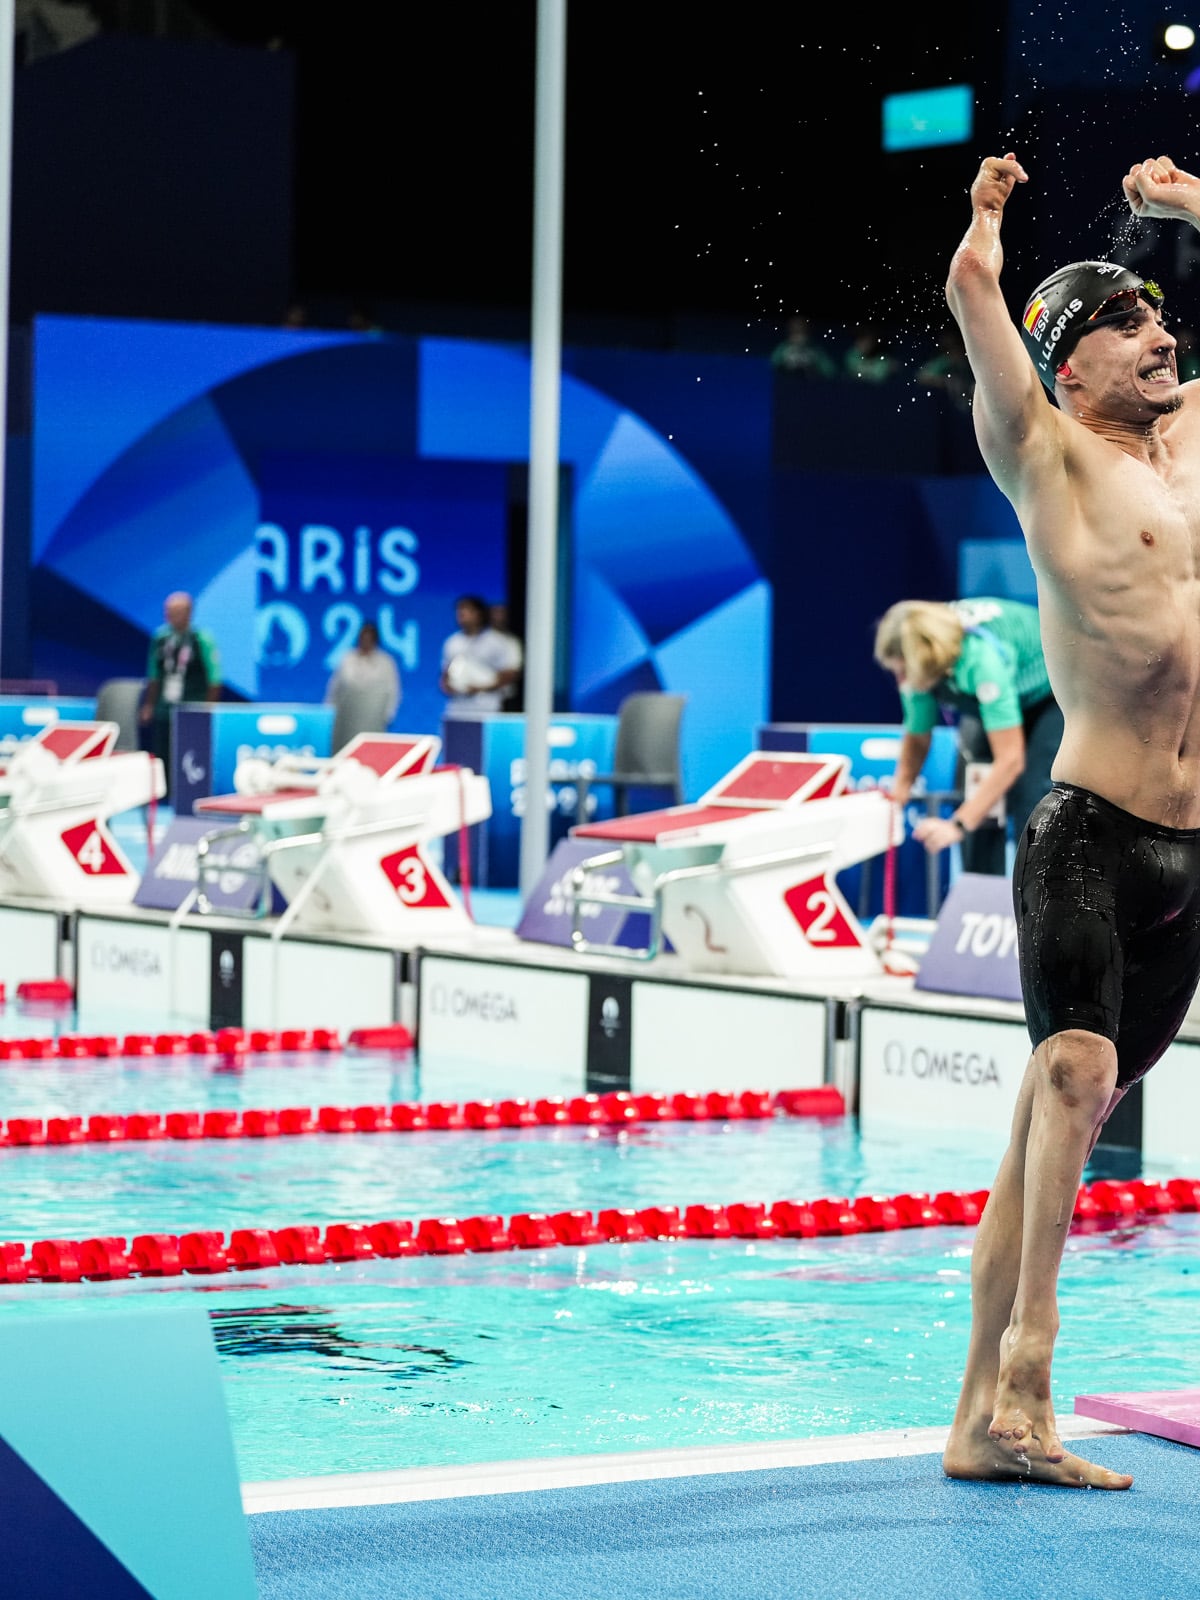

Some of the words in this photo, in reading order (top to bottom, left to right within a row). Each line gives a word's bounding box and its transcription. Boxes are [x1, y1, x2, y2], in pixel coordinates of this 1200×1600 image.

[1034, 309, 1050, 342] ESP
[1042, 298, 1084, 360] LLOPIS
[254, 523, 420, 596] ARiS
[254, 600, 419, 672] 024
[77, 829, 106, 873] 4
[396, 857, 427, 904] 3
[806, 890, 838, 942] 2
[955, 912, 1020, 959] TOY
[452, 988, 520, 1023] OMEGA
[911, 1047, 1002, 1087] OMEGA
